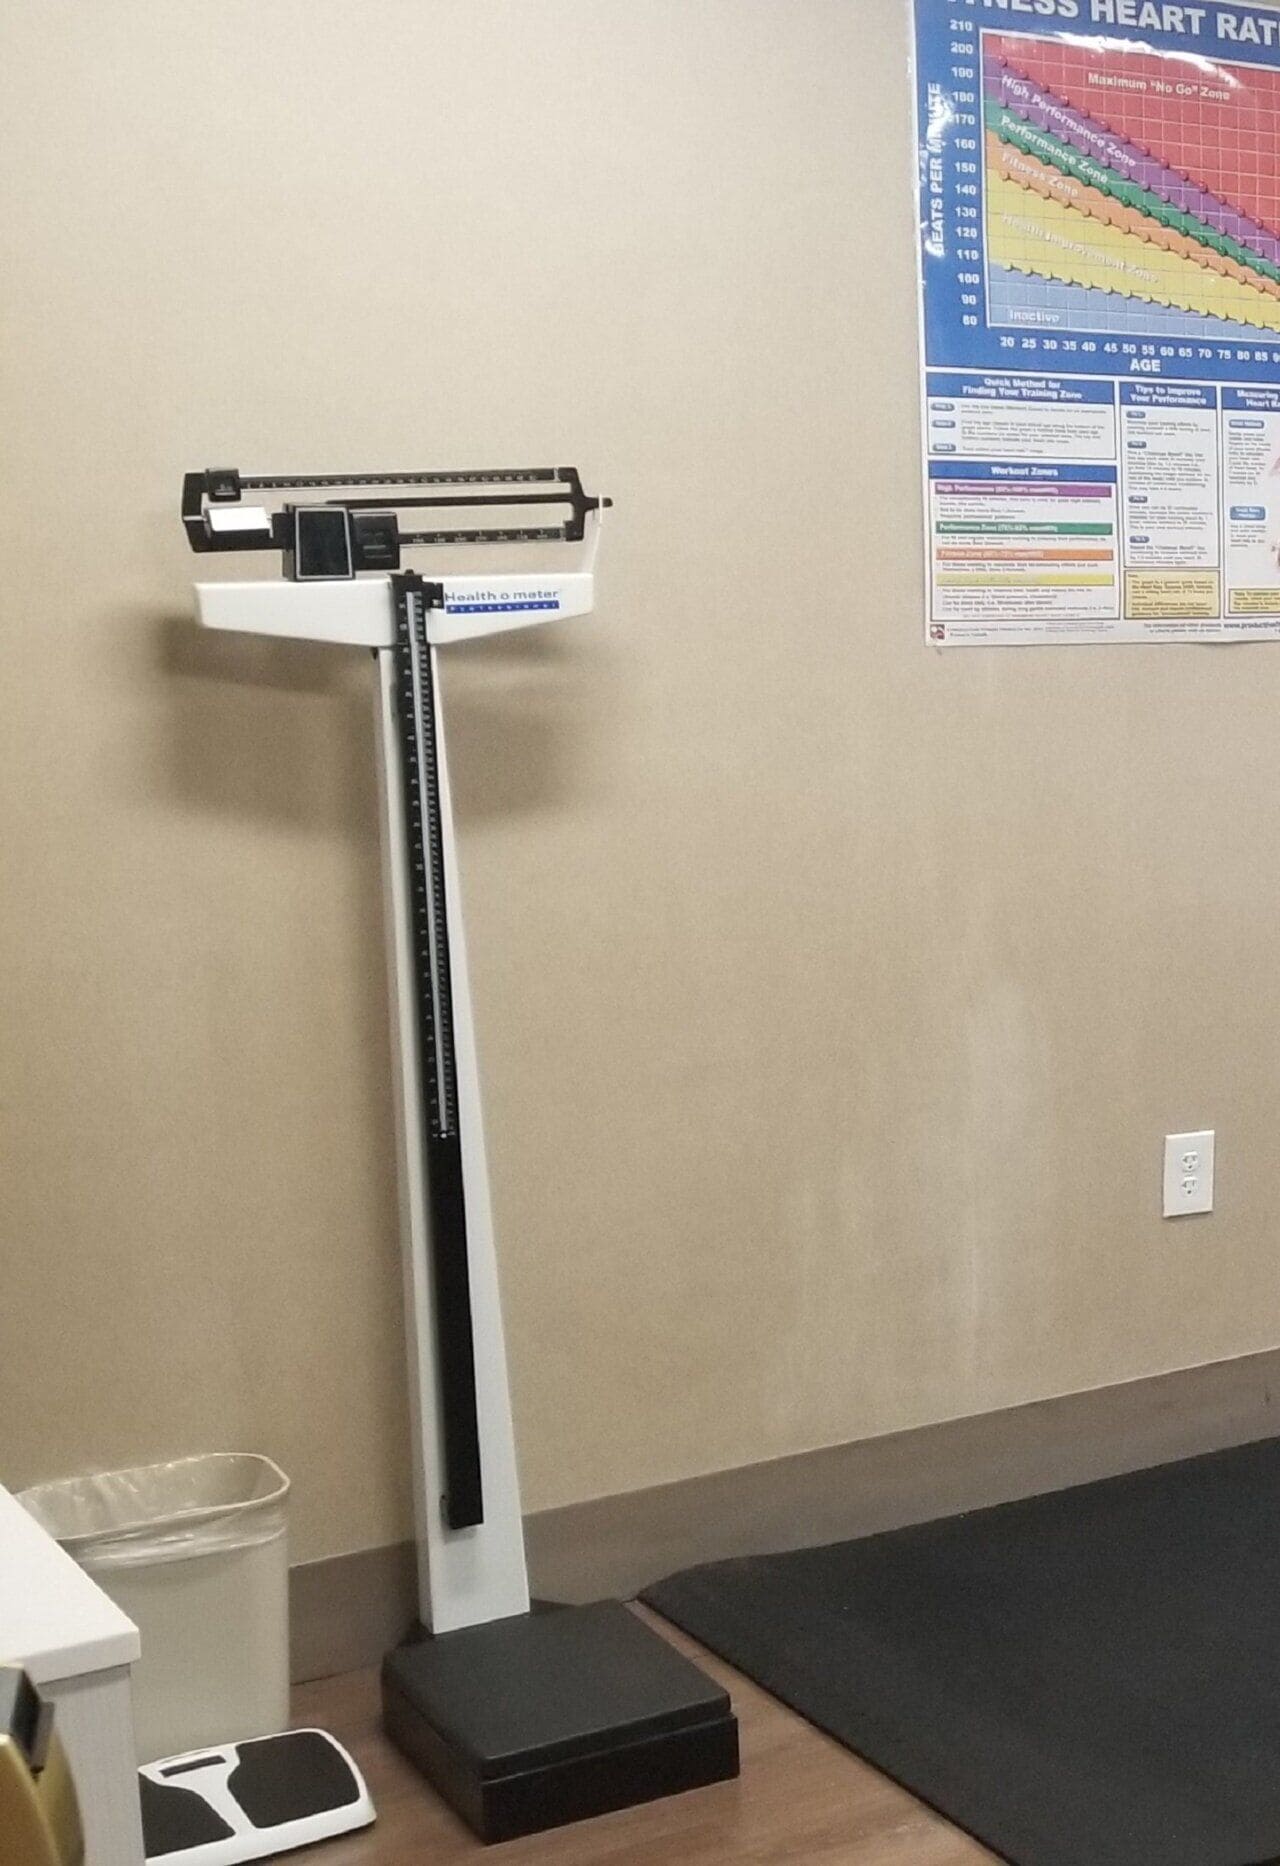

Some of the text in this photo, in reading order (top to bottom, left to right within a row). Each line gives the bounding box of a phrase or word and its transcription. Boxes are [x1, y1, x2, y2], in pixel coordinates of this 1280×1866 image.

[1091, 0, 1206, 35] HEART
[950, 19, 973, 31] 210
[951, 42, 973, 54] 200
[1088, 72, 1147, 91] Maximum
[1200, 86, 1230, 100] Zone
[952, 90, 974, 102] 180
[954, 113, 975, 125] 170
[1002, 75, 1137, 168] High Performance Zone
[954, 138, 976, 150] 160
[1001, 115, 1109, 183] Performance Zone
[955, 162, 976, 173] 150
[929, 157, 944, 194] PER
[1002, 152, 1079, 198] Fitness Zone
[955, 184, 977, 196] 140
[955, 207, 977, 218] 130
[956, 227, 977, 238] 120
[957, 249, 979, 260] 110
[957, 273, 980, 284] 100
[961, 294, 977, 305] 90
[1000, 336, 1015, 347] 20
[1021, 337, 1036, 349] 25
[1043, 339, 1057, 350] 30
[1062, 340, 1077, 351] 35
[1081, 341, 1096, 352] 40
[1104, 342, 1118, 353] 45
[1122, 343, 1136, 354] 50
[1160, 345, 1174, 357] 60
[1178, 346, 1193, 358] 65
[1198, 347, 1212, 359] 70
[1217, 349, 1231, 360] 75
[1130, 358, 1161, 372] AGE
[984, 377, 1011, 388] Quick
[1013, 379, 1046, 389] Method
[962, 385, 1082, 400] Finding Your Training Zone
[1135, 384, 1201, 397] Tips to Improve
[1237, 390, 1278, 400] Measuring
[1130, 394, 1207, 406] Your Performance
[1246, 398, 1270, 408] Heart
[991, 466, 1059, 476] Workout Zones
[445, 590, 559, 602] Health o meter
